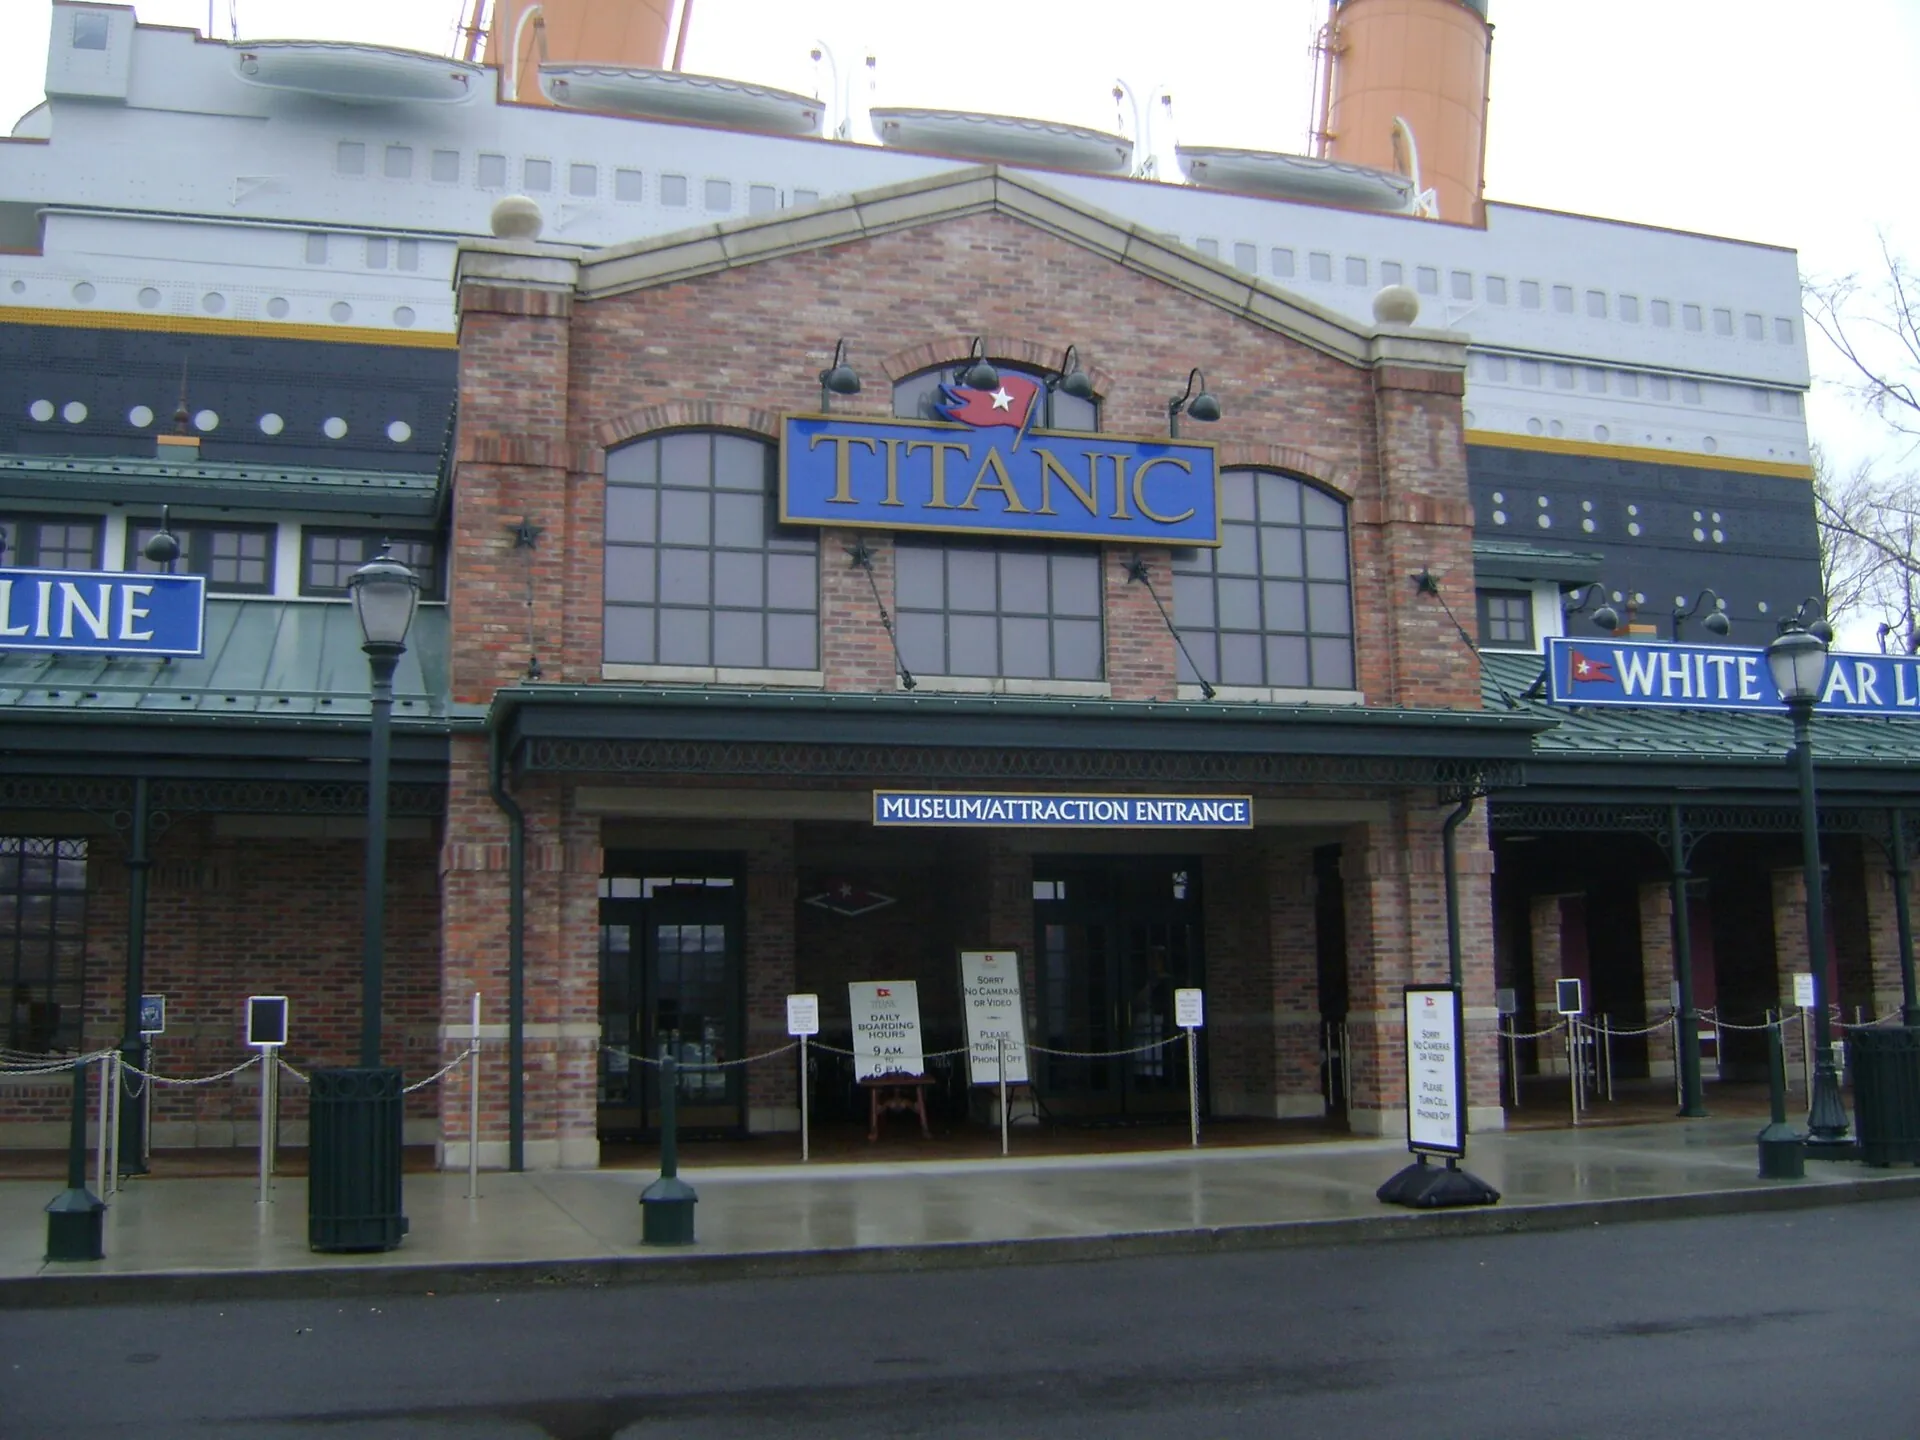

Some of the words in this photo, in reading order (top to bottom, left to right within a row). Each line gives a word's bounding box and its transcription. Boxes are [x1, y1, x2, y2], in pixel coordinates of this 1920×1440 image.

[809, 434, 1196, 524] TITANIC
[0, 579, 155, 641] LINE
[1613, 650, 1762, 700] WHITE
[1778, 661, 1883, 705] AR
[882, 798, 1129, 822] MUSEUM/ATTRACTION
[1135, 802, 1245, 823] ENTRANCE
[977, 975, 1004, 984] SORRY
[979, 986, 1019, 996] CAMERAS
[986, 998, 1012, 1007] VIDEO
[870, 1013, 900, 1022] DAILY
[858, 1022, 914, 1031] BOARDING
[868, 1030, 905, 1039] HOURS
[980, 1030, 1009, 1039] PLEASE
[873, 1045, 881, 1056] 9
[874, 1063, 882, 1073] 6
